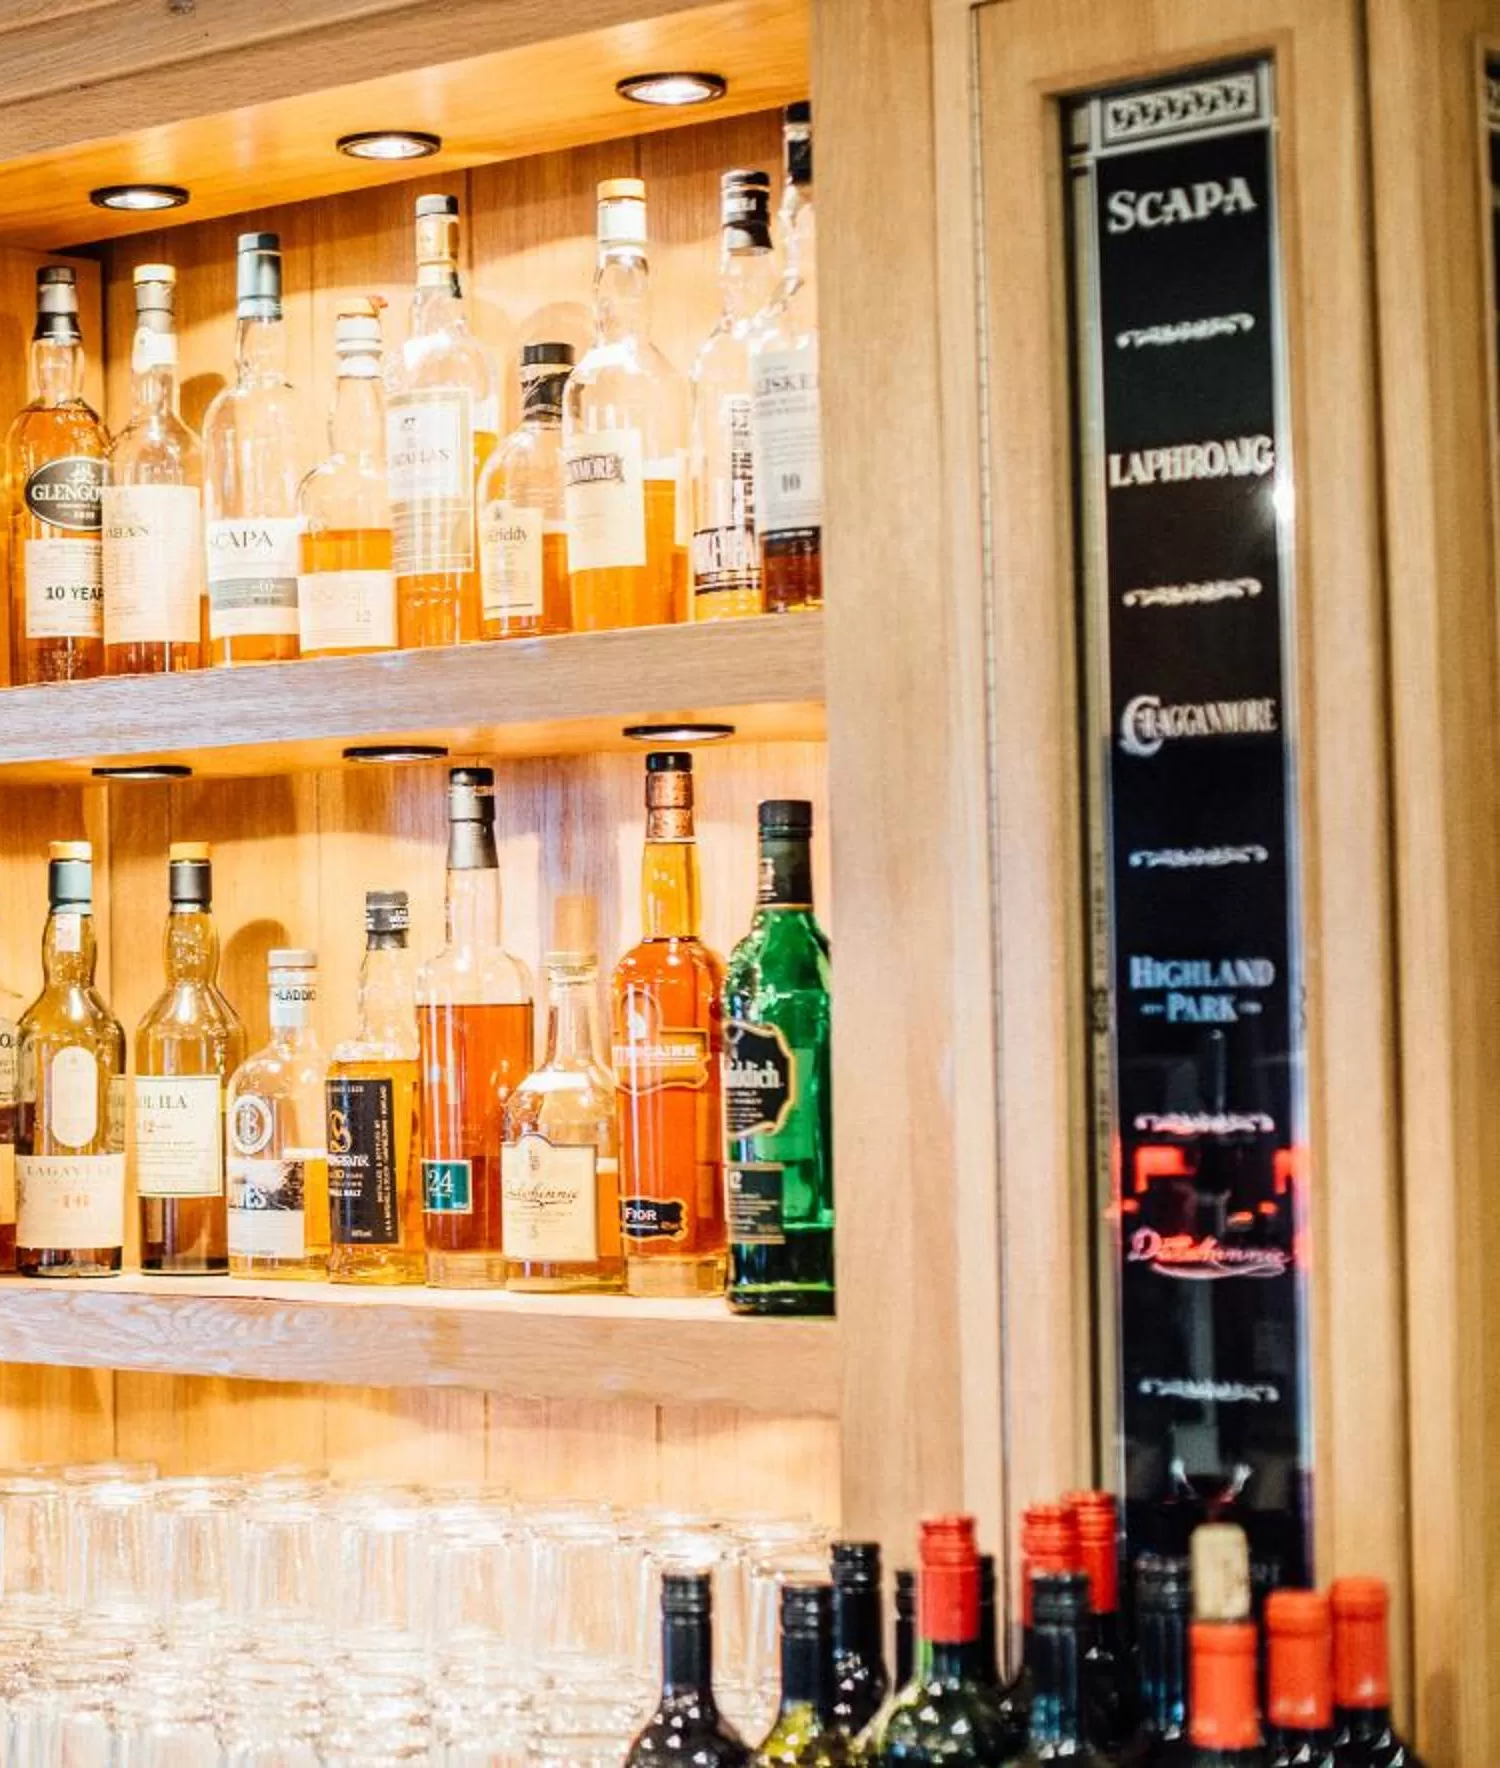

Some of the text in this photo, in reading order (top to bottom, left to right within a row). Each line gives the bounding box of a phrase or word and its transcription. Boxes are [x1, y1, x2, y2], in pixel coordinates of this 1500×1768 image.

[1107, 176, 1257, 234] SCAPA
[45, 586, 66, 601] 10
[1130, 955, 1276, 989] HIGHLAND
[1167, 992, 1239, 1022] PARK
[428, 1168, 454, 1193] 24
[625, 1207, 657, 1221] FIOR
